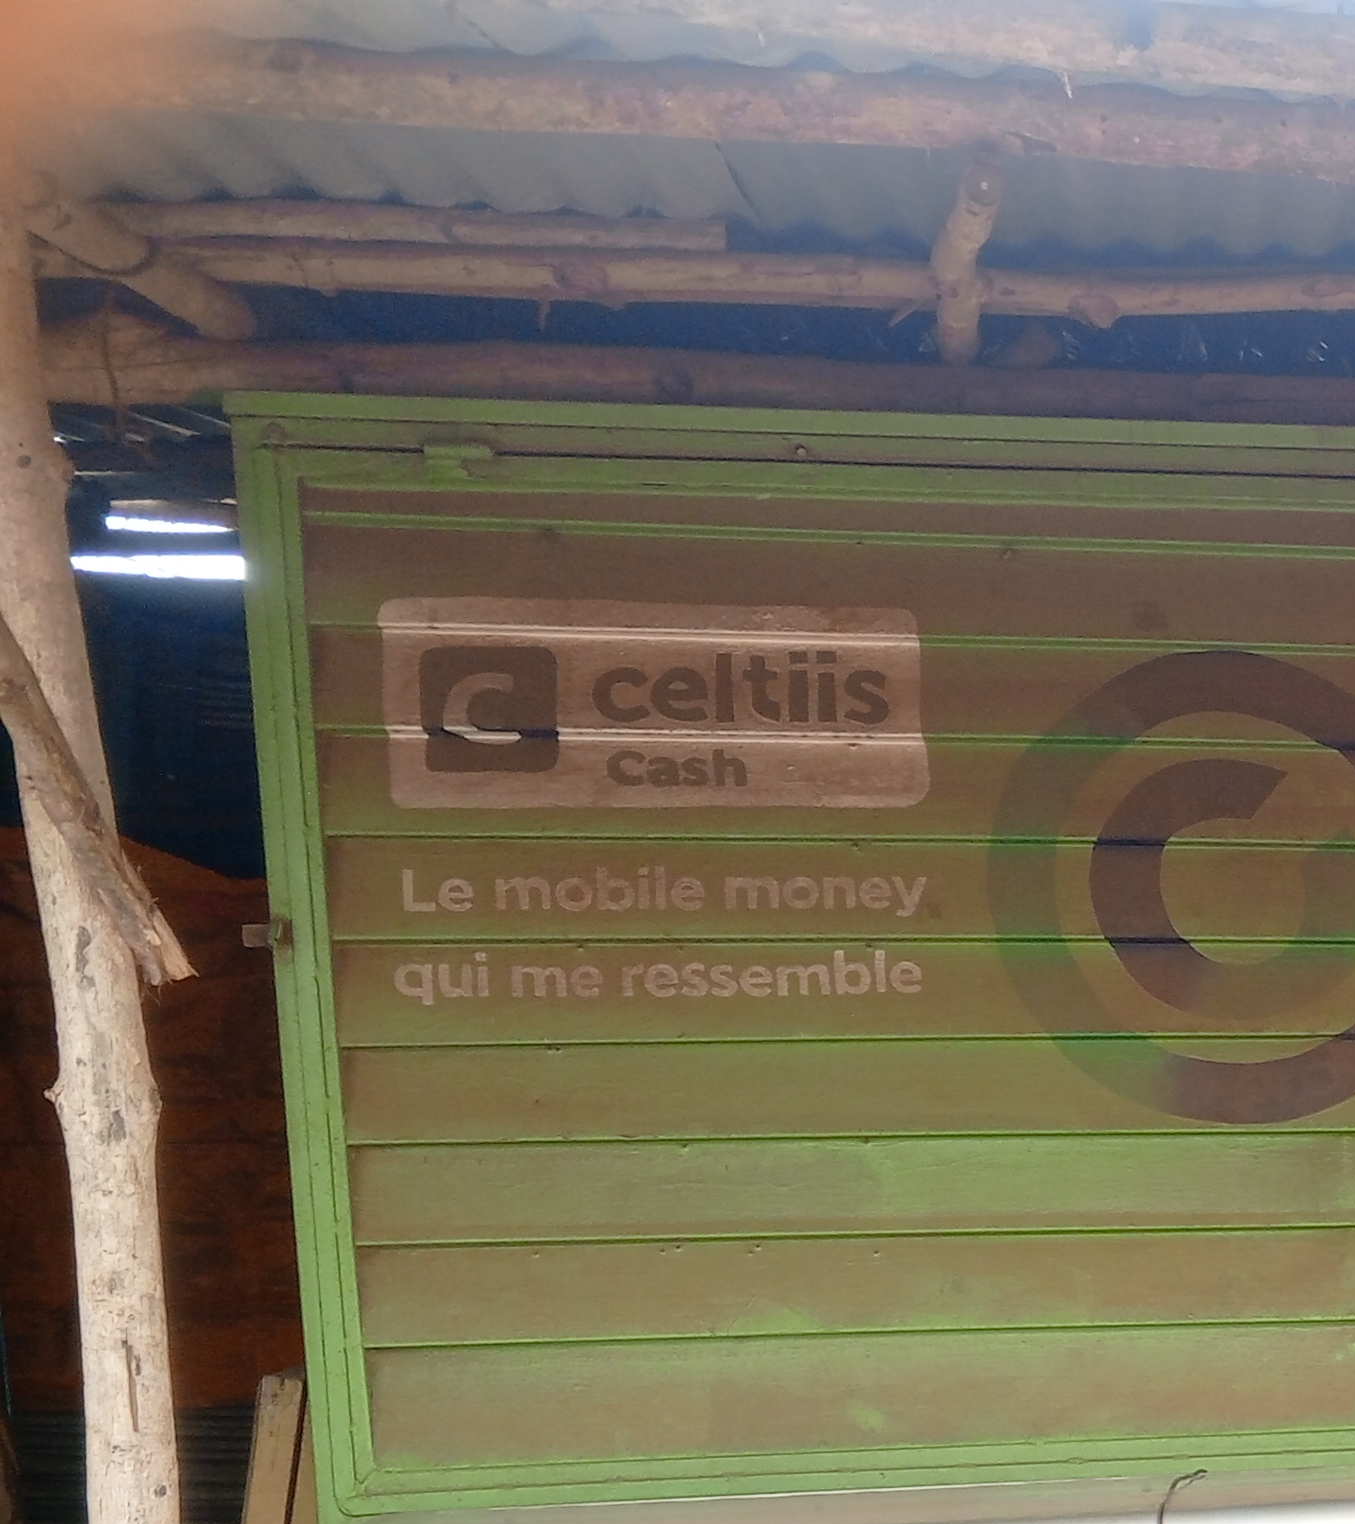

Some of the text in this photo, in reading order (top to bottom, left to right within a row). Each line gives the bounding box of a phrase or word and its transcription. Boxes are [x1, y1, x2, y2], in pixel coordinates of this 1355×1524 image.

[592, 651, 889, 725] celtiis
[606, 749, 748, 788] Cash
[402, 866, 927, 918] Le mobile money
[394, 950, 923, 1006] qui me ressemble
